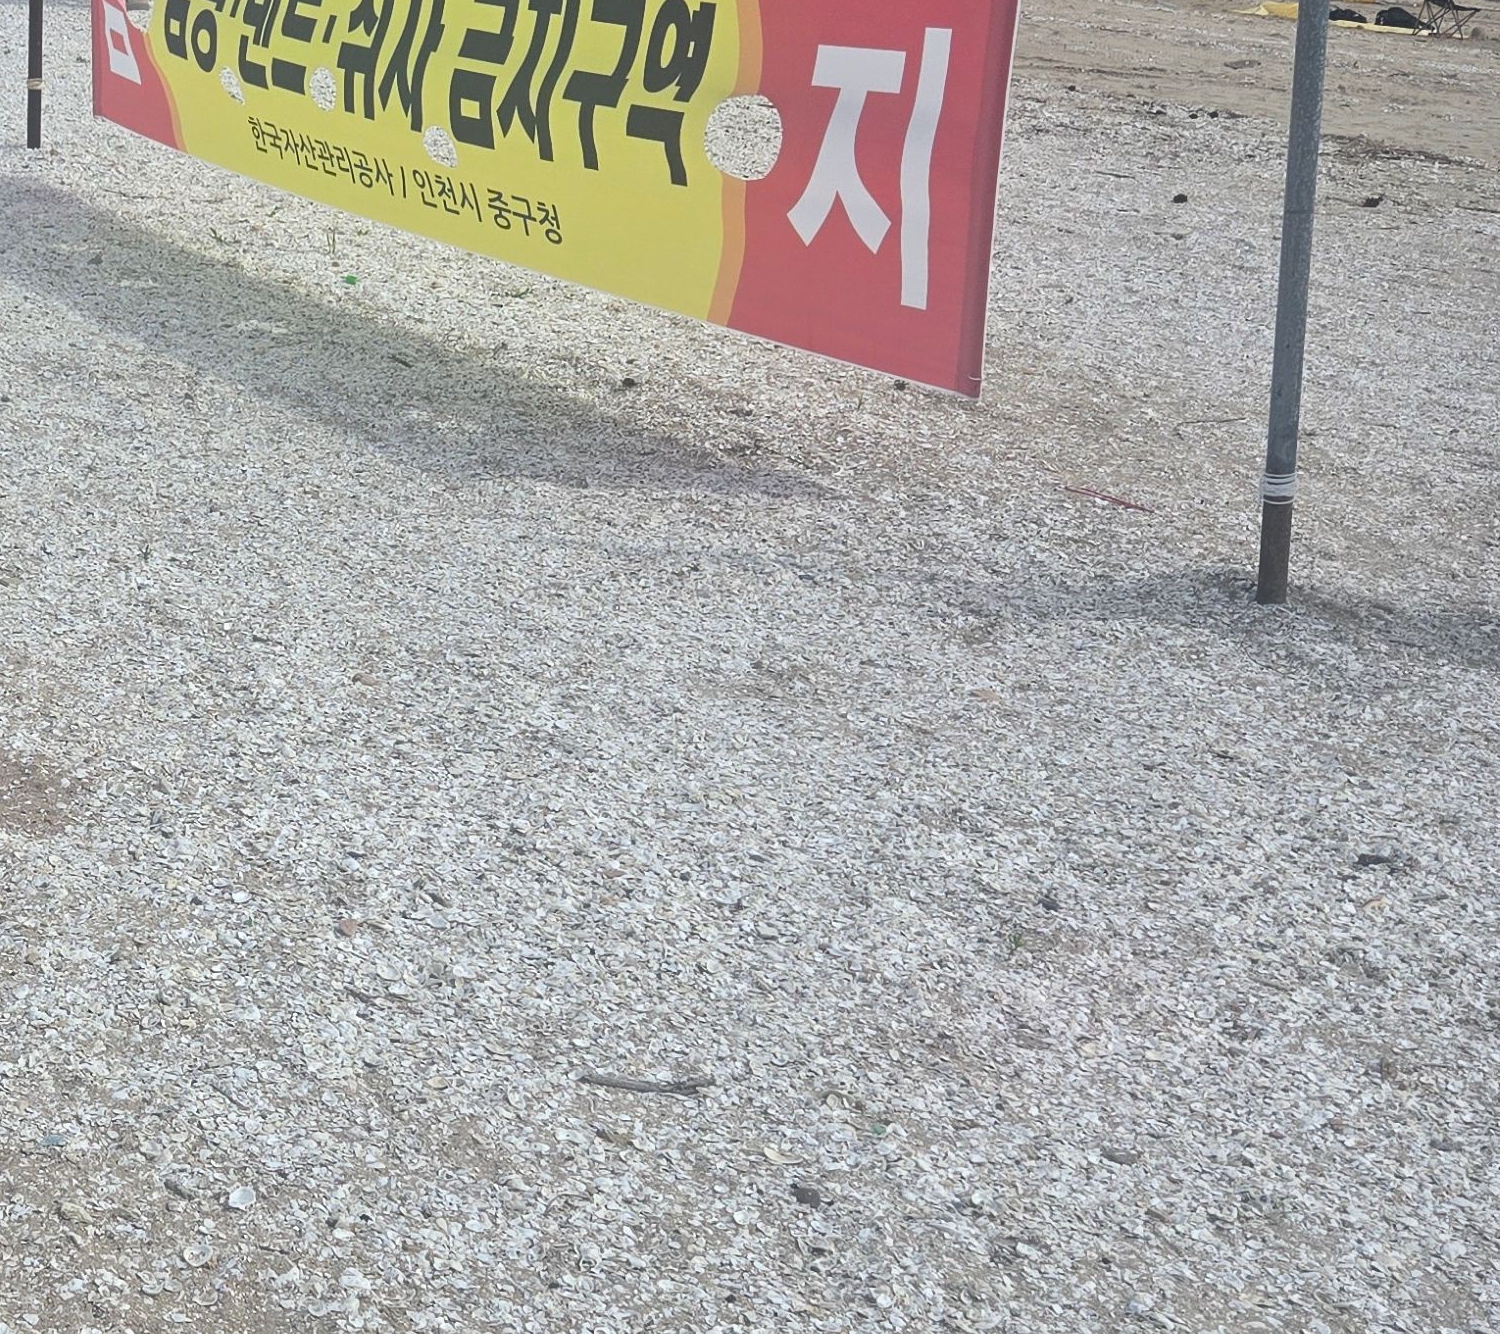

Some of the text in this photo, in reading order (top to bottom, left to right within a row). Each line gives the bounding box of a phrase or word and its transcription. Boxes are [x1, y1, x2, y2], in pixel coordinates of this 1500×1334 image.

[248, 116, 394, 196] 한국자산관리공사
[412, 169, 483, 223] 인천시
[487, 188, 563, 245] 중구청
[786, 27, 952, 310] 지
